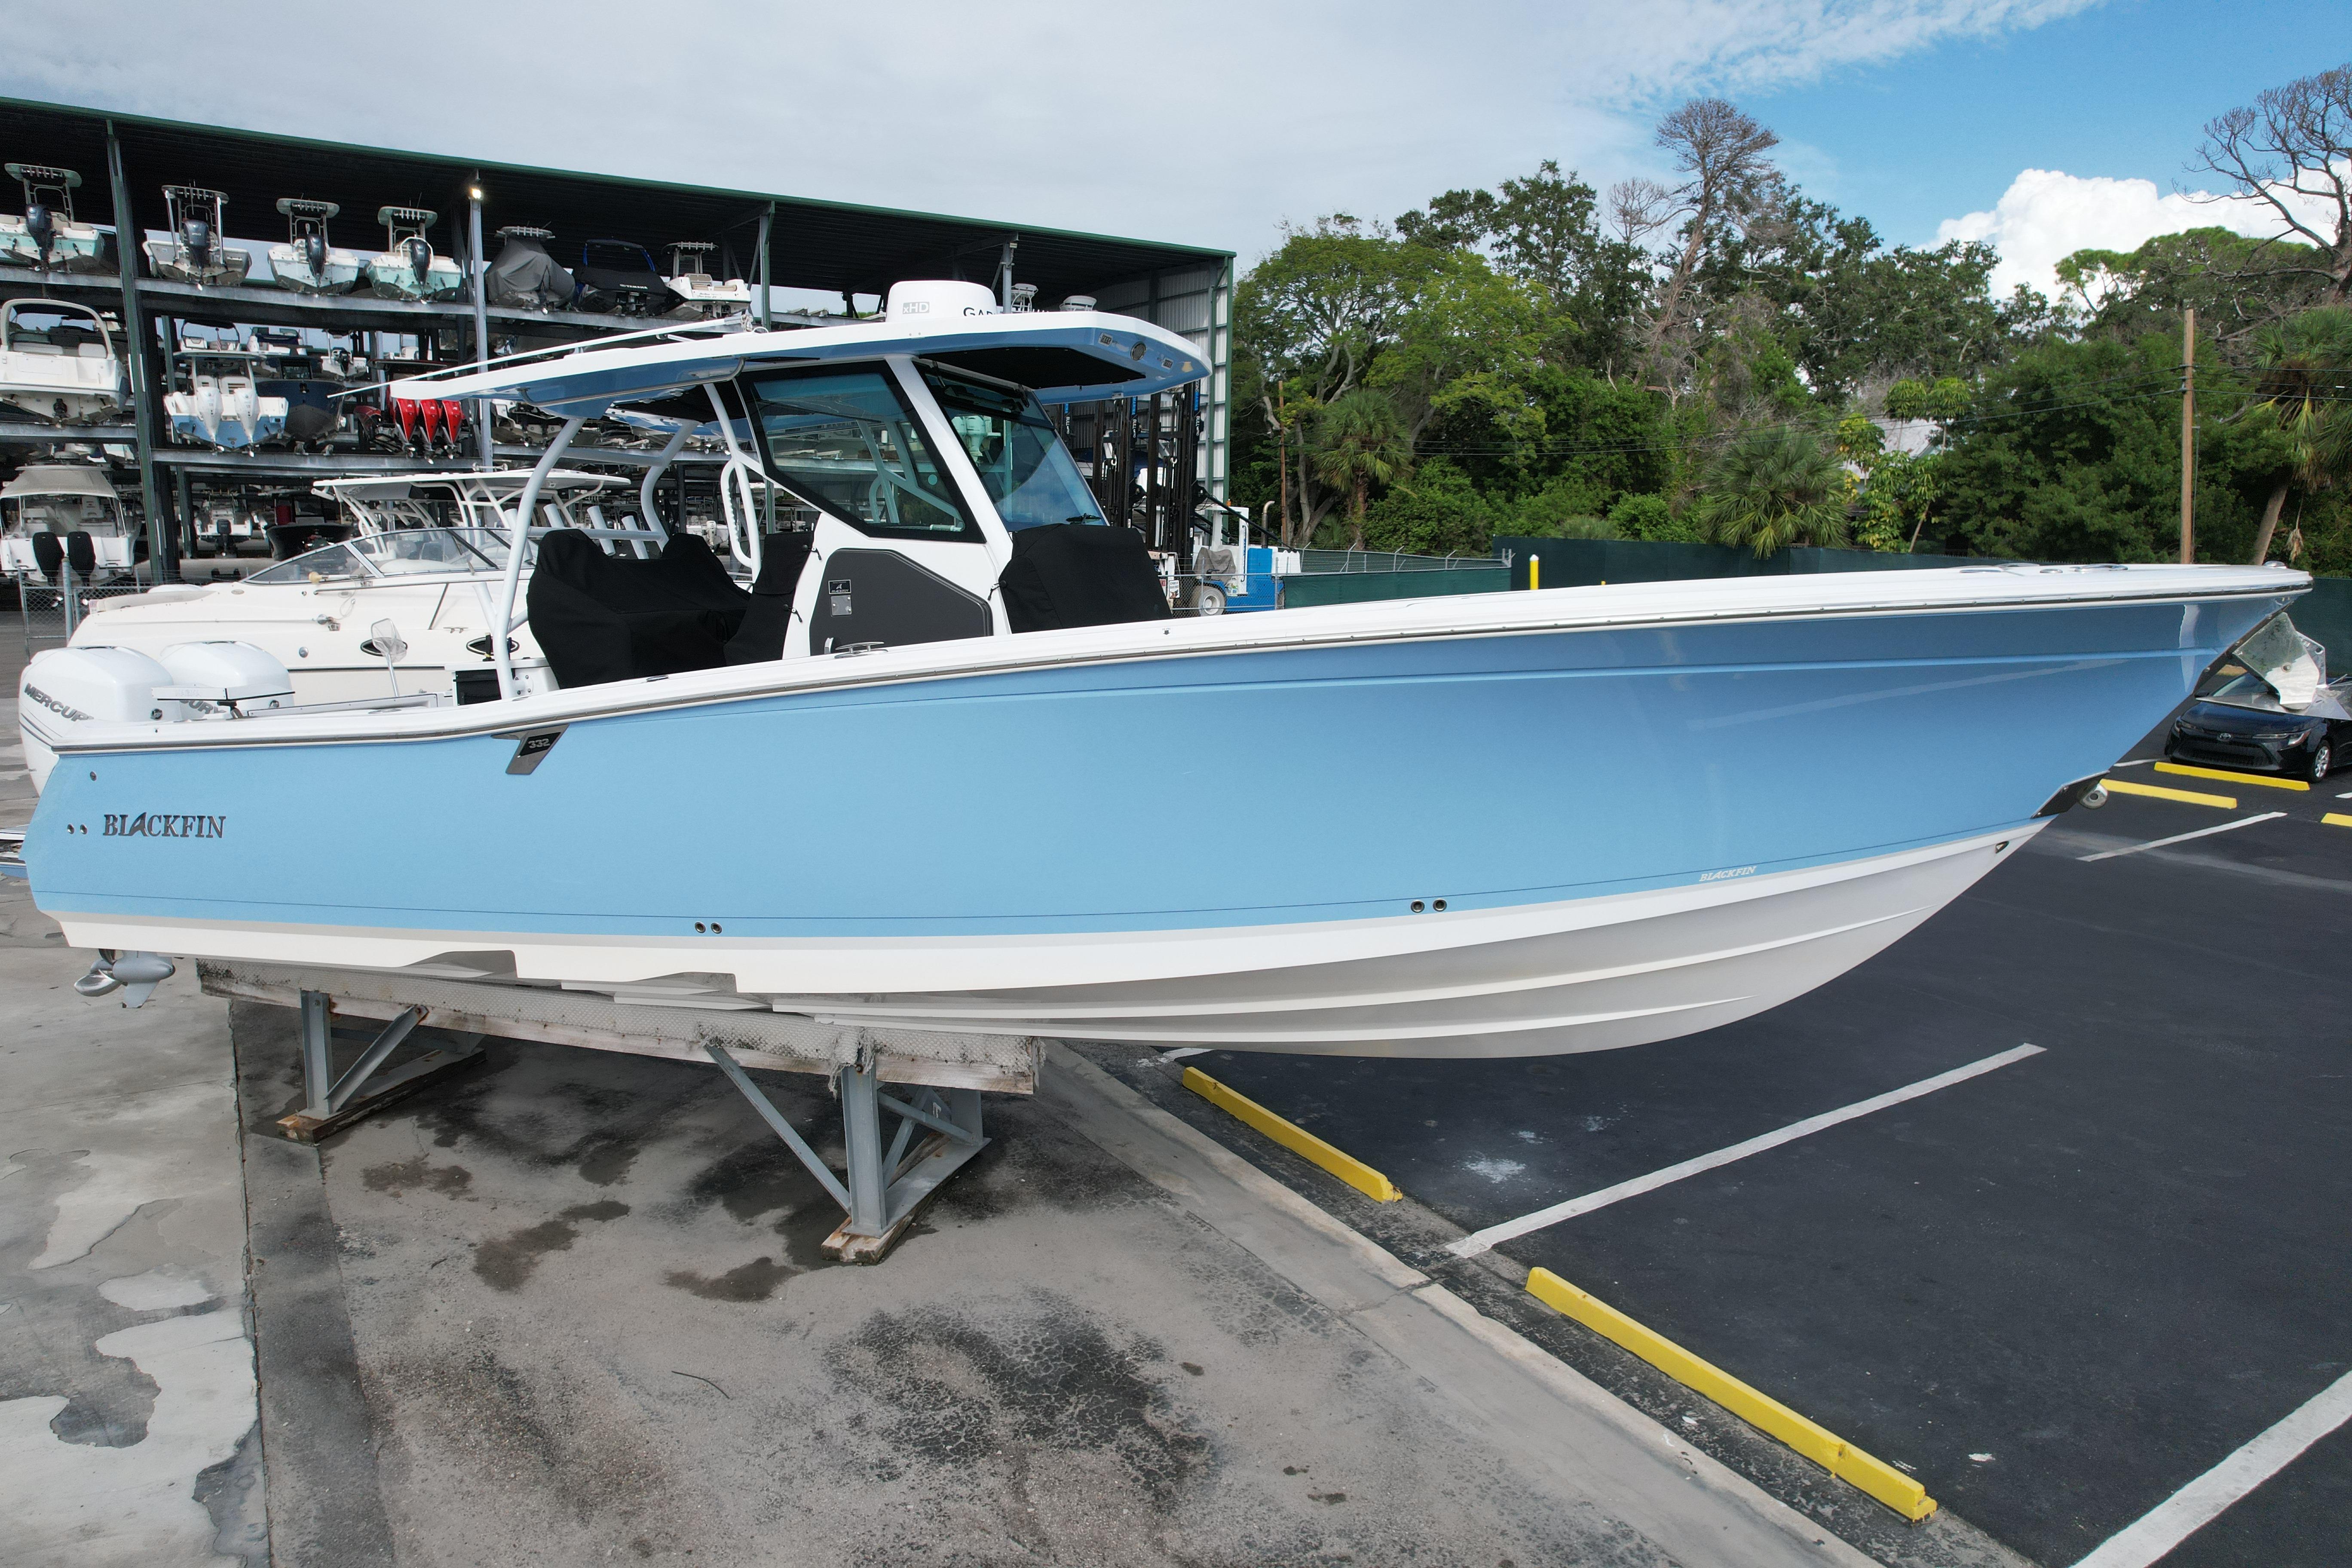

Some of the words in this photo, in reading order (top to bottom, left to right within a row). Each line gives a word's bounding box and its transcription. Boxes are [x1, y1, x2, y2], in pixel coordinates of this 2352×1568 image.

[903, 303, 928, 313] xHD
[24, 683, 94, 722] MERCUR
[528, 738, 550, 748] 332
[103, 812, 226, 838] BLACKFIN
[1699, 866, 1757, 881] BLACKFIN
